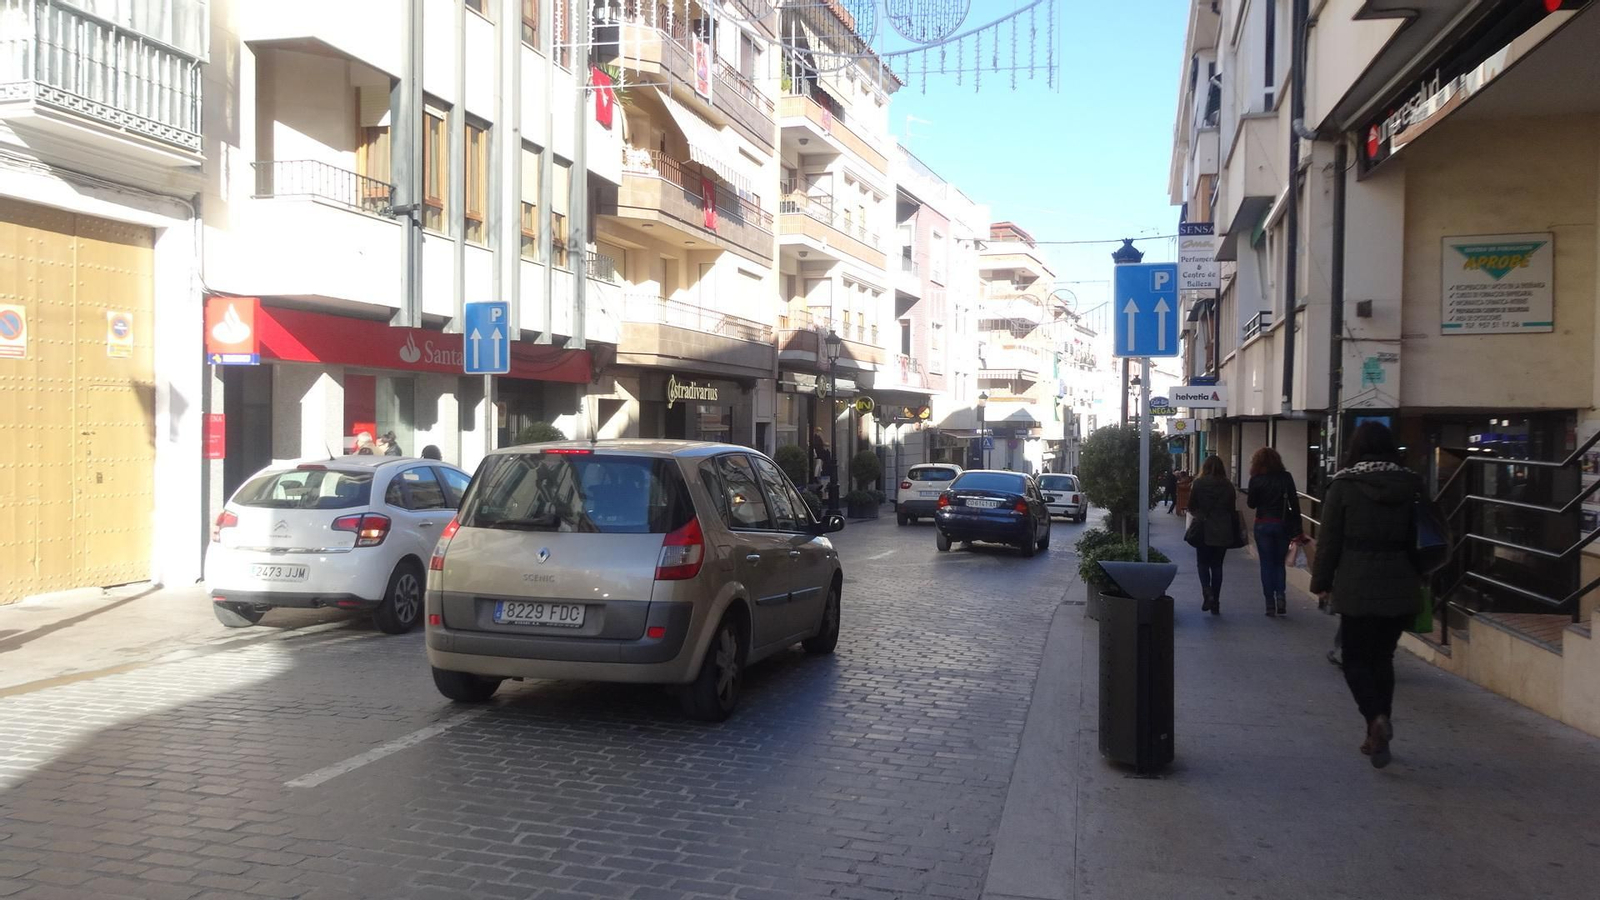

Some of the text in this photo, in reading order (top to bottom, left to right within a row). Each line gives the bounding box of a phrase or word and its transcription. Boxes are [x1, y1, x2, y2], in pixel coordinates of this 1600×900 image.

[1155, 272, 1169, 290] P
[491, 308, 502, 322] P
[1175, 392, 1209, 401] helvetia
[256, 566, 306, 578] 2473 JJM
[523, 574, 555, 582] SCENIC
[506, 603, 544, 619] 8229
[549, 604, 580, 621] FDC
